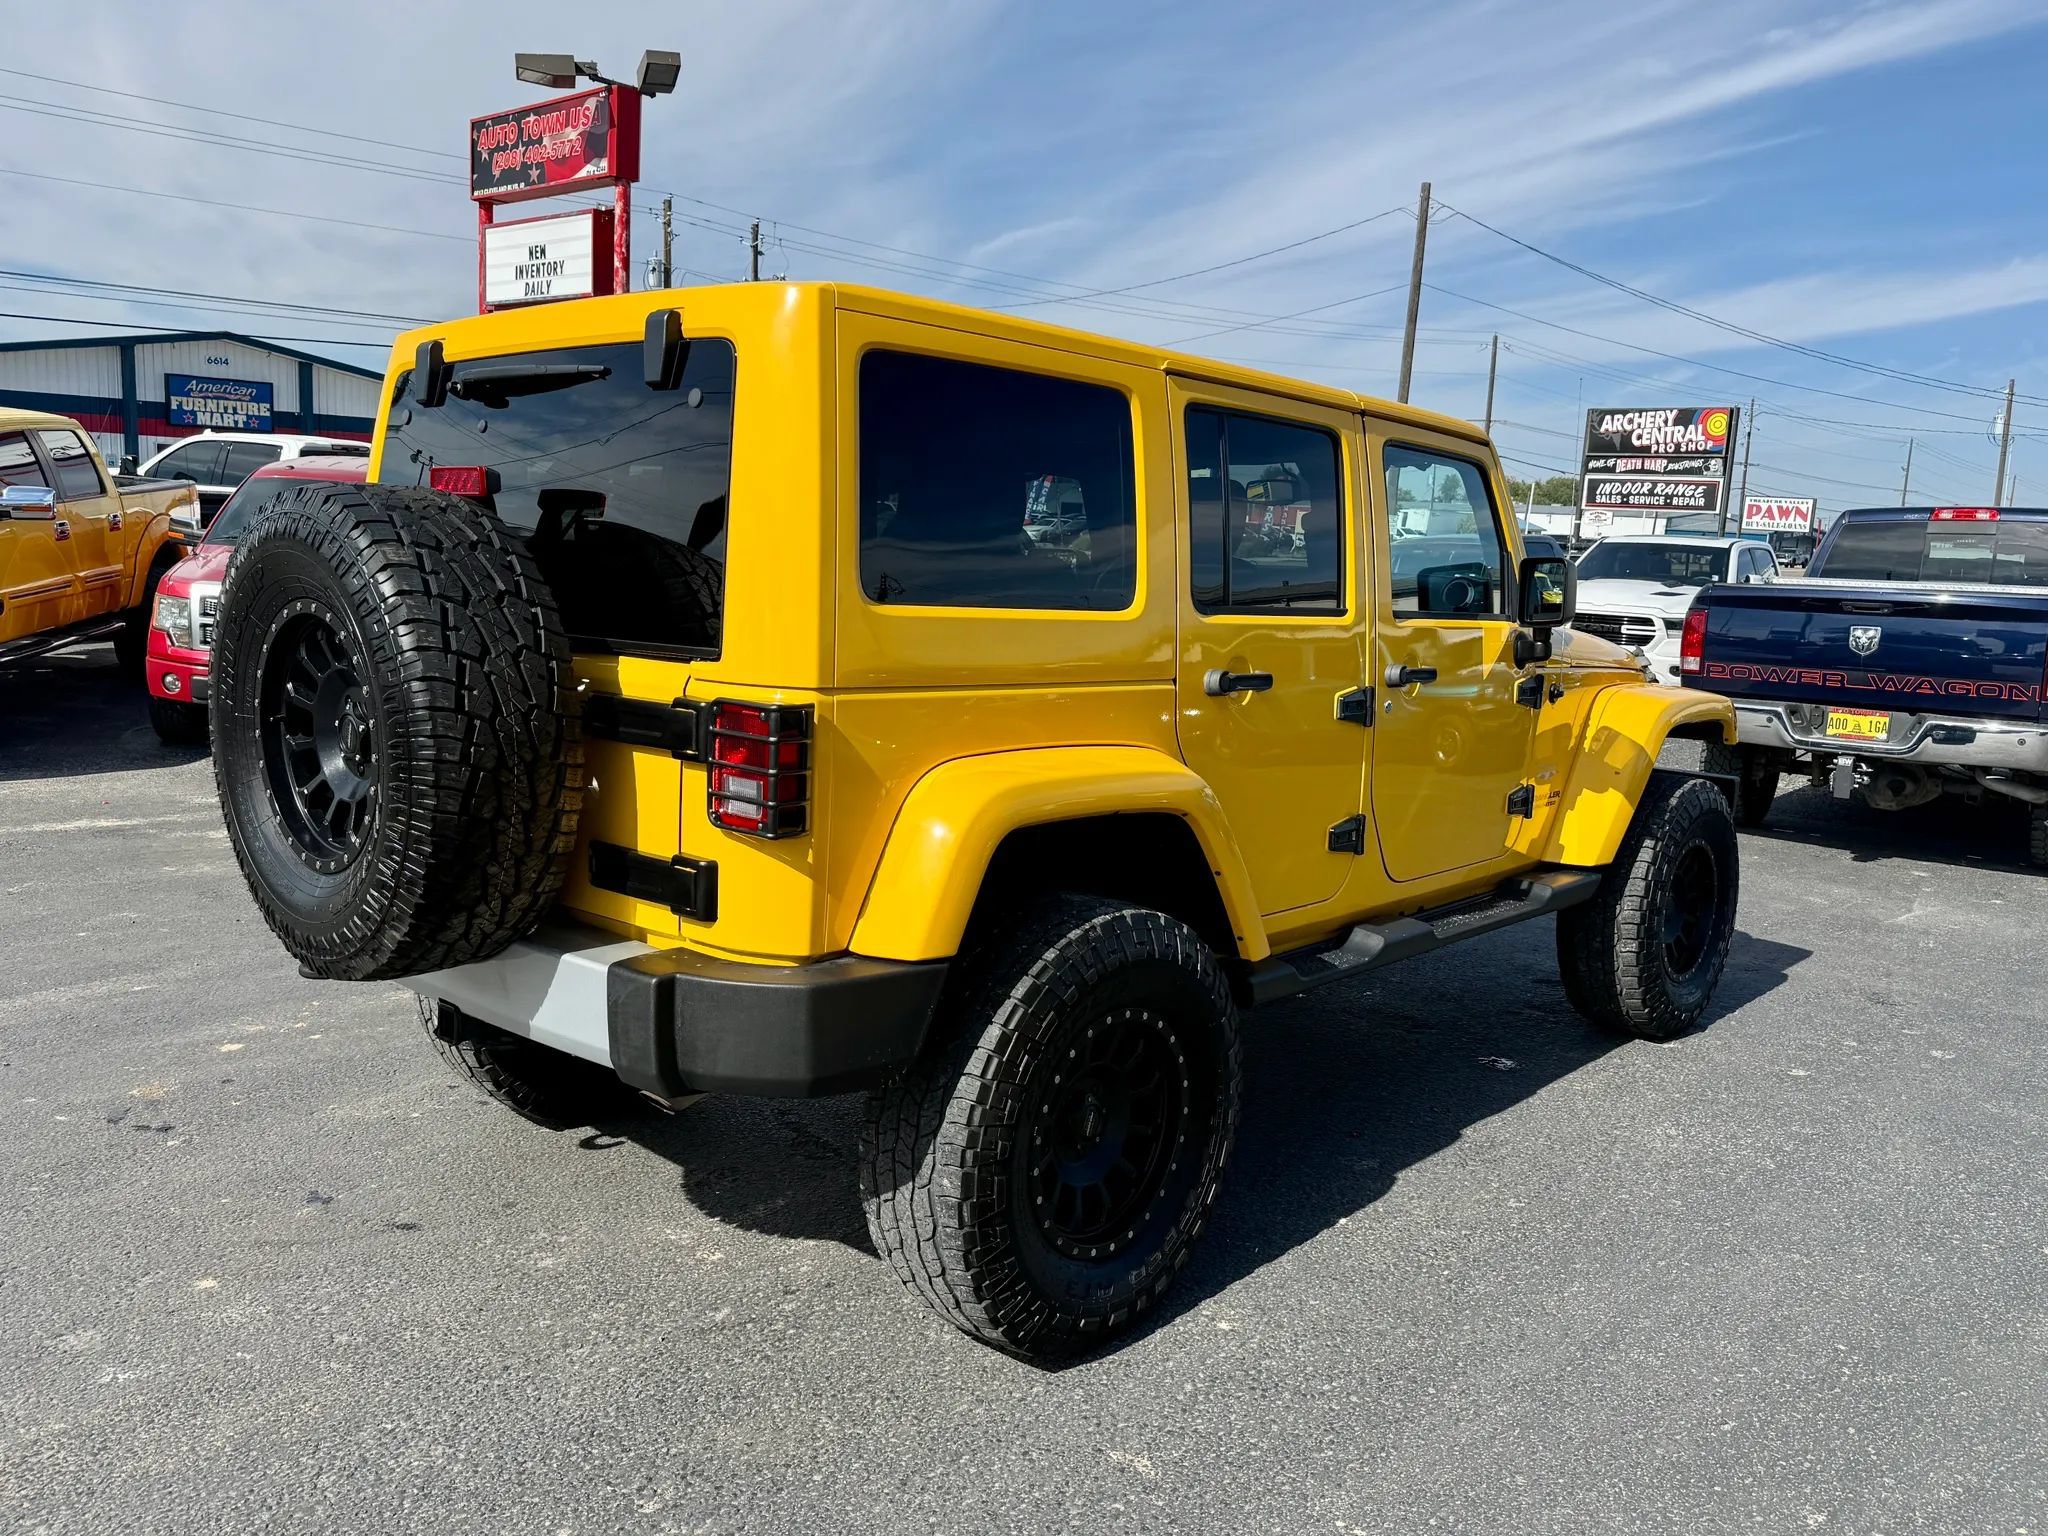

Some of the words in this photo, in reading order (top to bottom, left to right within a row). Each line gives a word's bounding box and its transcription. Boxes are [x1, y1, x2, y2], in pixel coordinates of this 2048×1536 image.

[477, 121, 518, 151] AUTO
[521, 110, 566, 141] TOWN
[569, 101, 601, 131] USA
[492, 148, 521, 175] (208)
[528, 244, 546, 261] NEW
[515, 259, 565, 280] INVENTORY
[524, 279, 552, 297] DAILY
[206, 356, 230, 366] 6614
[184, 380, 257, 397] American
[170, 395, 271, 417] FURNITURE
[196, 411, 248, 428] MART
[1600, 409, 1680, 434] ARCHERY
[1631, 424, 1706, 447] CENTRAL
[1650, 442, 1675, 454] PRO
[1680, 441, 1714, 453] SHOP
[1606, 457, 1617, 468] OF
[1615, 457, 1642, 473] DEATH
[1643, 457, 1668, 473] HARP
[1596, 482, 1652, 495] INDOOR
[1653, 483, 1707, 498] RANGE
[1595, 495, 1622, 504] SALES
[1628, 495, 1665, 505] SERVICE
[1672, 497, 1705, 506] REPAIR
[1746, 503, 1810, 523] PAWN
[1703, 662, 1848, 689] POWER
[1867, 674, 2040, 702] WAGON
